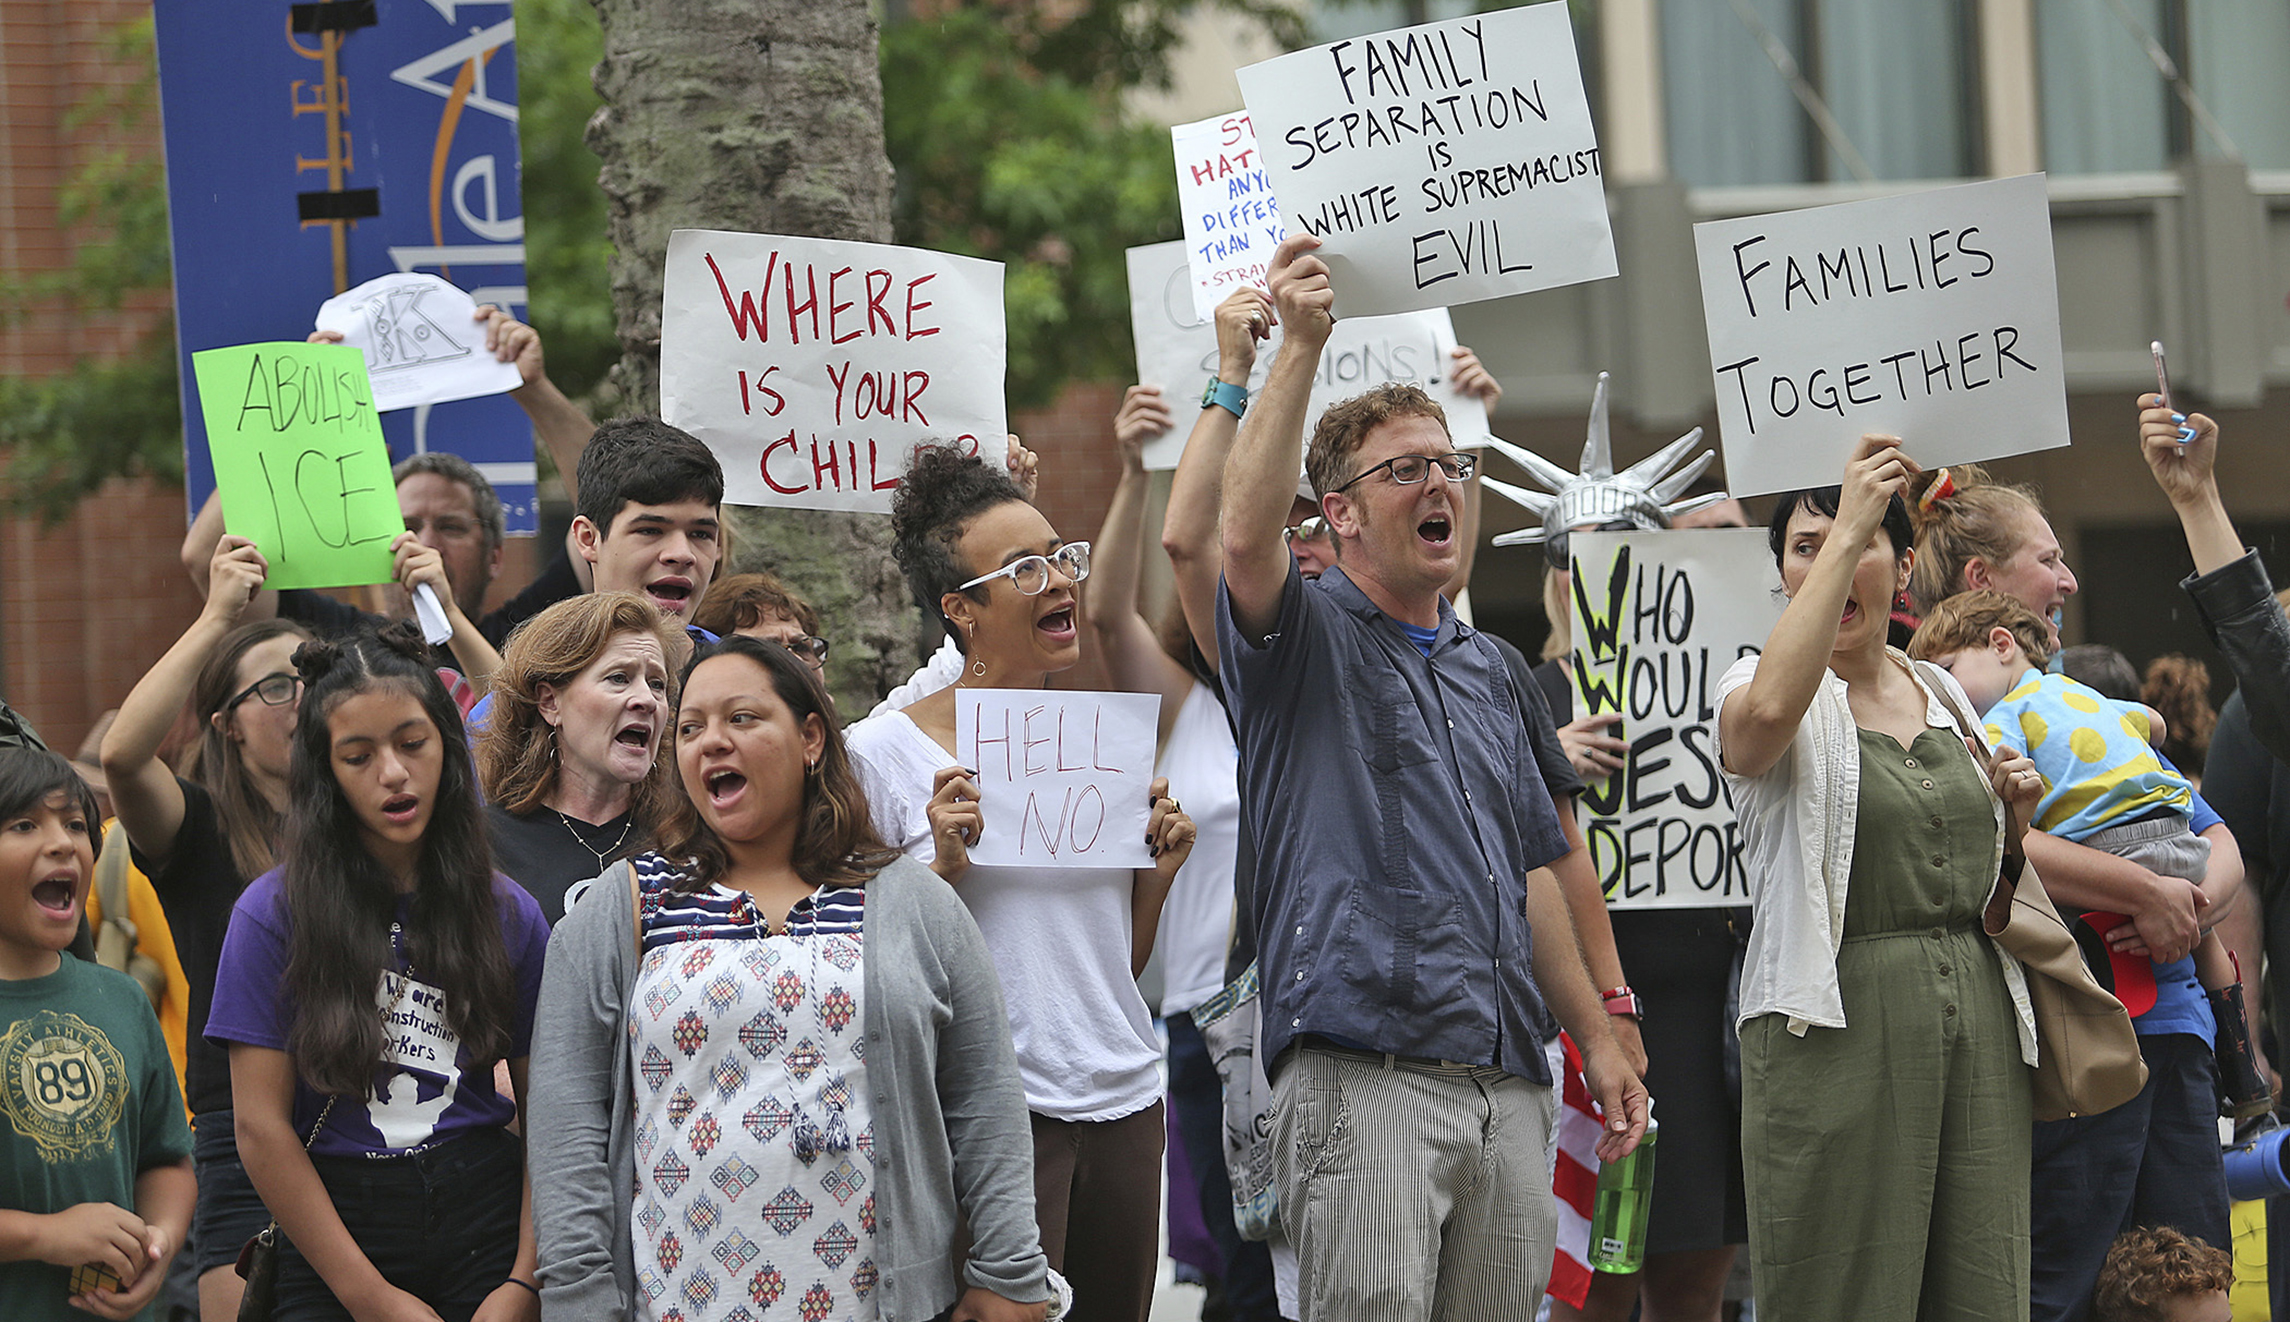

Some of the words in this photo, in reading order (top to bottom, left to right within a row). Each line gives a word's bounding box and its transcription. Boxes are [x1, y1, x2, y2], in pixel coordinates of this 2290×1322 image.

[1330, 19, 1489, 105] FAMILY
[1285, 78, 1548, 171] SEPARATION
[1427, 141, 1453, 171] IS
[1190, 148, 1264, 187] HAT
[1297, 184, 1401, 237] WHITE
[1421, 148, 1602, 213] SUPREMACIST
[1199, 231, 1250, 264] THAN
[1412, 219, 1533, 290] EVIL
[1732, 226, 1995, 318] FAMILIES
[704, 250, 941, 345] WHERE
[237, 353, 371, 433] ABOLISH
[738, 365, 787, 417] IS
[826, 361, 931, 426] YOUR
[1716, 325, 2038, 435] TOGETHER
[258, 449, 391, 562] ICE
[1571, 543, 1694, 662] WHO
[976, 702, 1125, 789] HELL
[1581, 714, 1732, 815] JES
[1020, 784, 1106, 860] NO.
[411, 989, 444, 1013] are
[8, 1032, 36, 1099] VARSITY
[44, 1025, 118, 1086] ATHLETICS
[35, 1058, 92, 1105] 89
